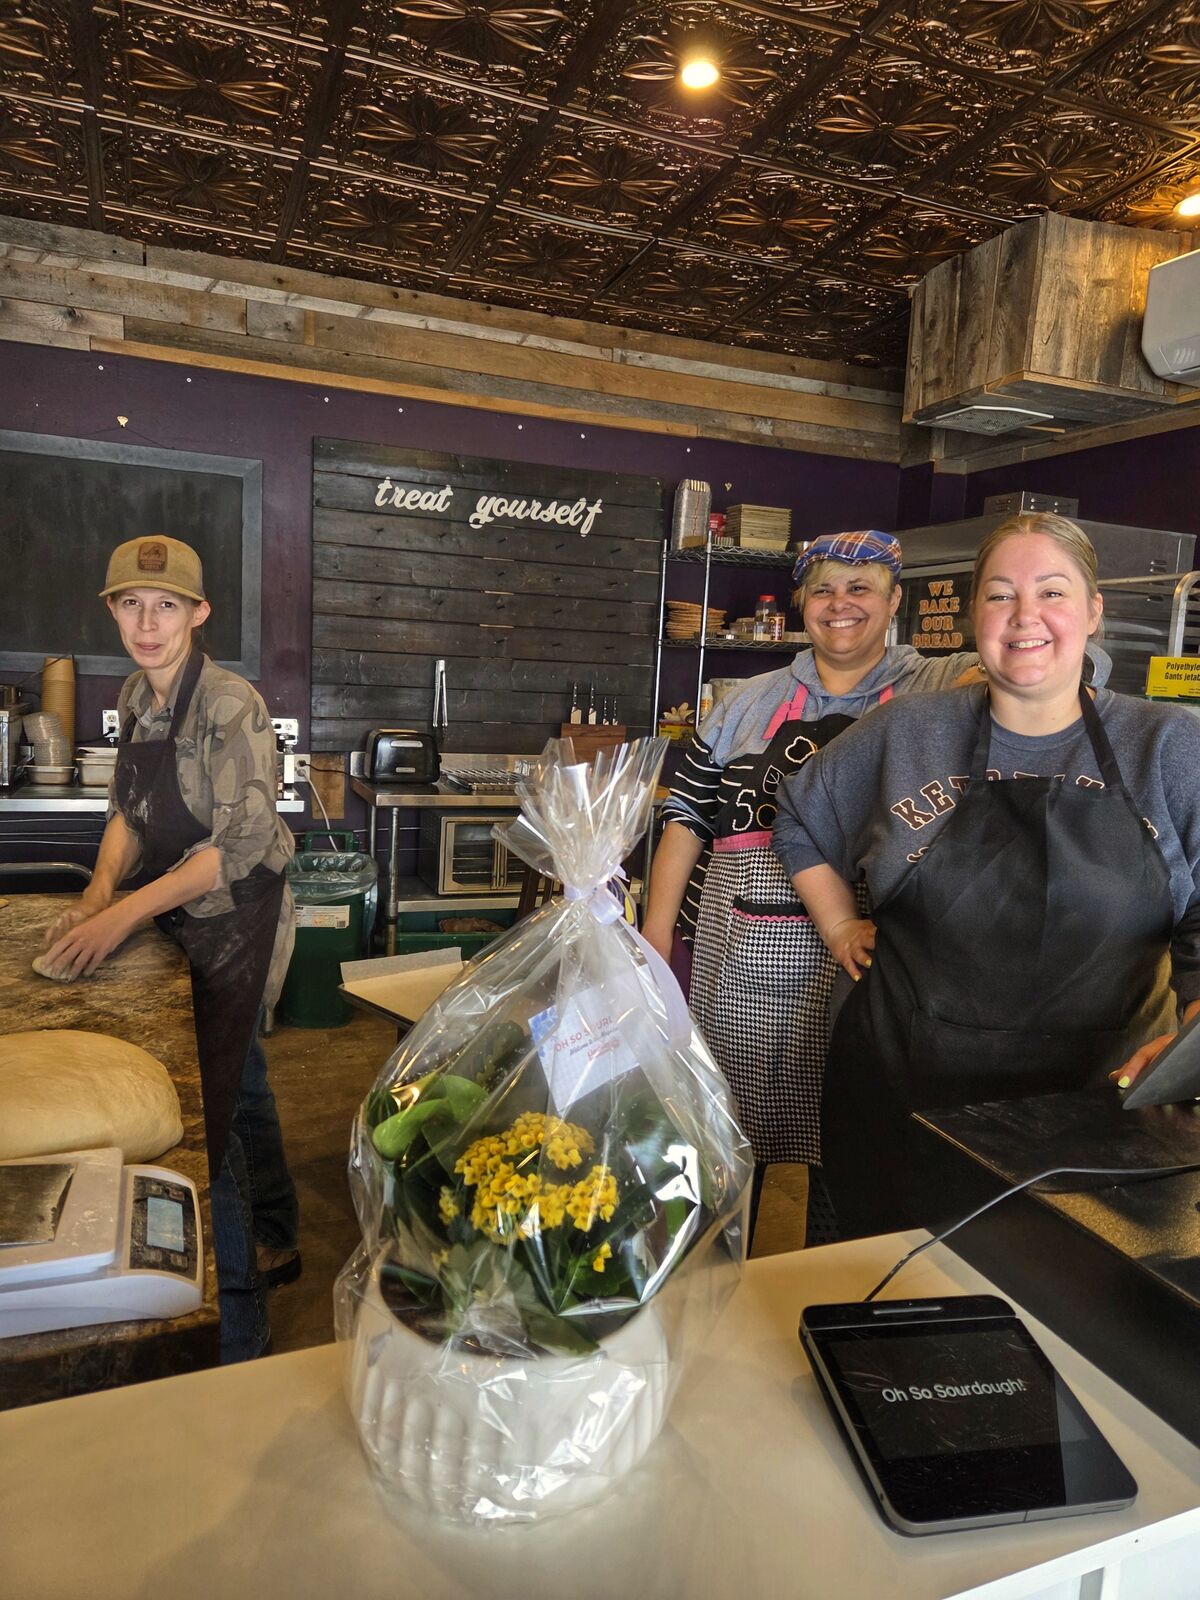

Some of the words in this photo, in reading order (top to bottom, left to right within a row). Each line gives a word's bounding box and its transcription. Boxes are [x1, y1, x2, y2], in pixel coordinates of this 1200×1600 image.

[374, 476, 454, 512] treat
[469, 495, 603, 537] yourself
[928, 580, 953, 597] WE
[919, 596, 960, 615] BAKE
[922, 615, 954, 631] OUR
[912, 632, 963, 648] BREAD
[1164, 672, 1182, 680] Gants
[881, 1387, 909, 1402] Oh
[909, 1386, 933, 1400] So
[933, 1378, 1028, 1399] Sourdough!
